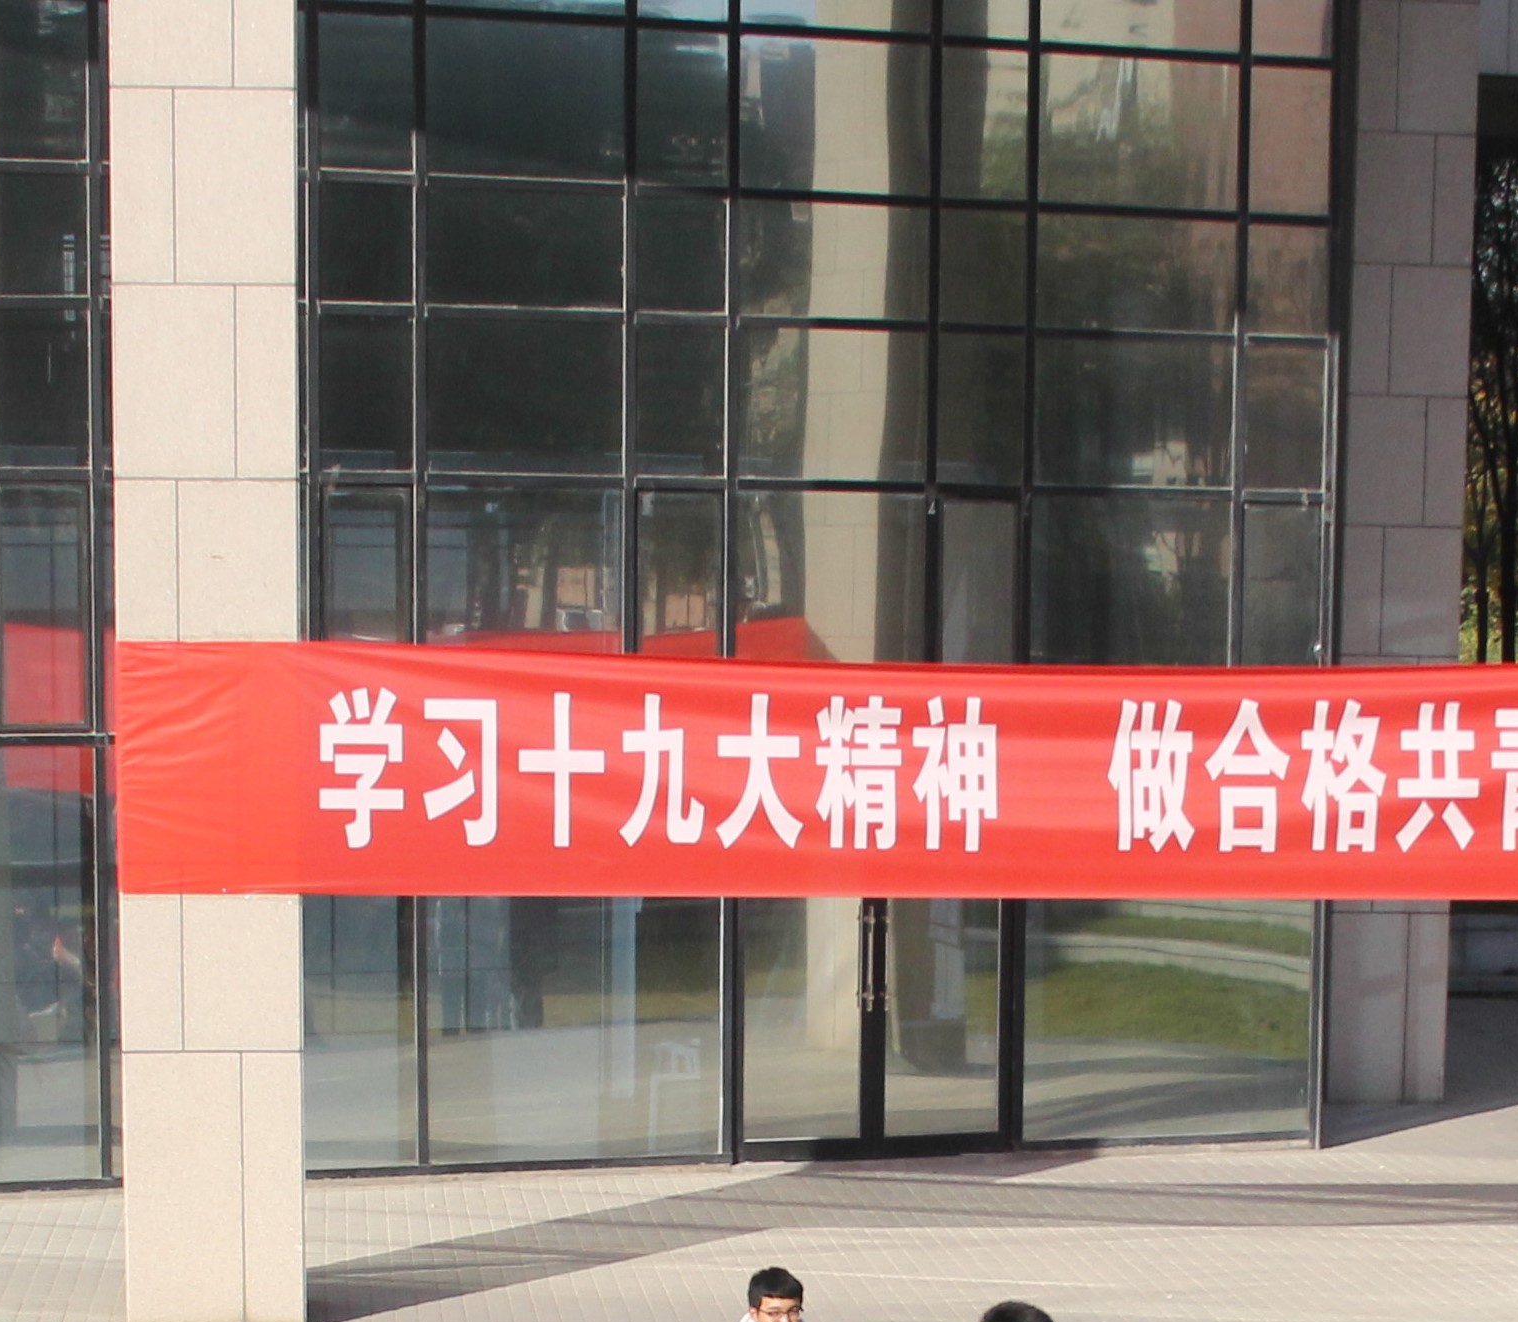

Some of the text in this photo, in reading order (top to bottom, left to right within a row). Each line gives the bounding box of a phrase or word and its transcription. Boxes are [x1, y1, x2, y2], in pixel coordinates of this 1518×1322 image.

[317, 686, 999, 852] 学习十九大精神
